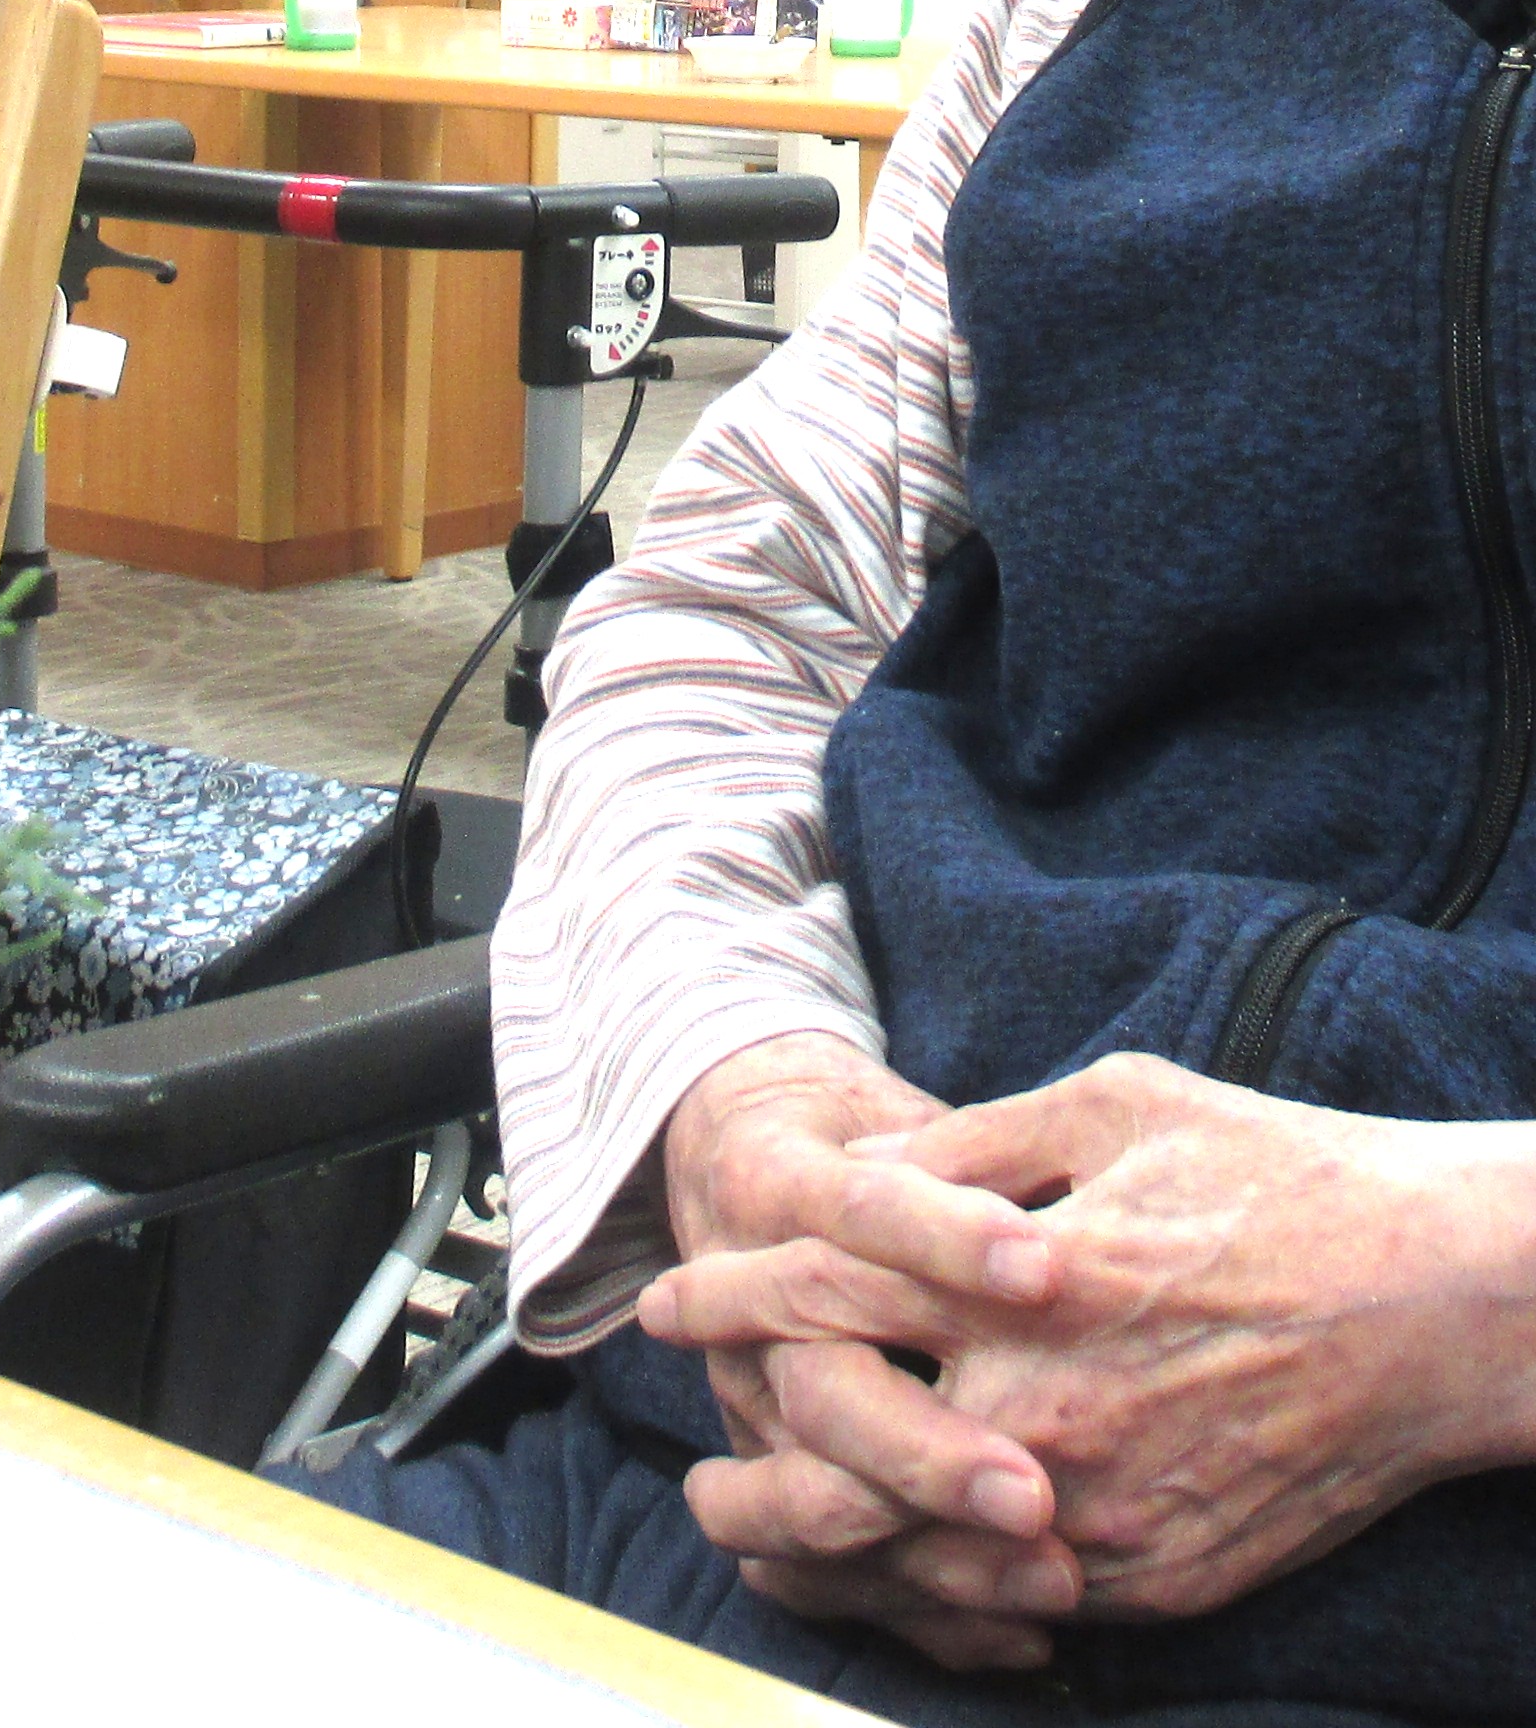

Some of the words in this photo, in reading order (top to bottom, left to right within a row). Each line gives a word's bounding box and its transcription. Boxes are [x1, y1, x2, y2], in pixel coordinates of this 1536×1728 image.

[597, 249, 635, 262] ブレーキ
[595, 323, 623, 335] ロック
